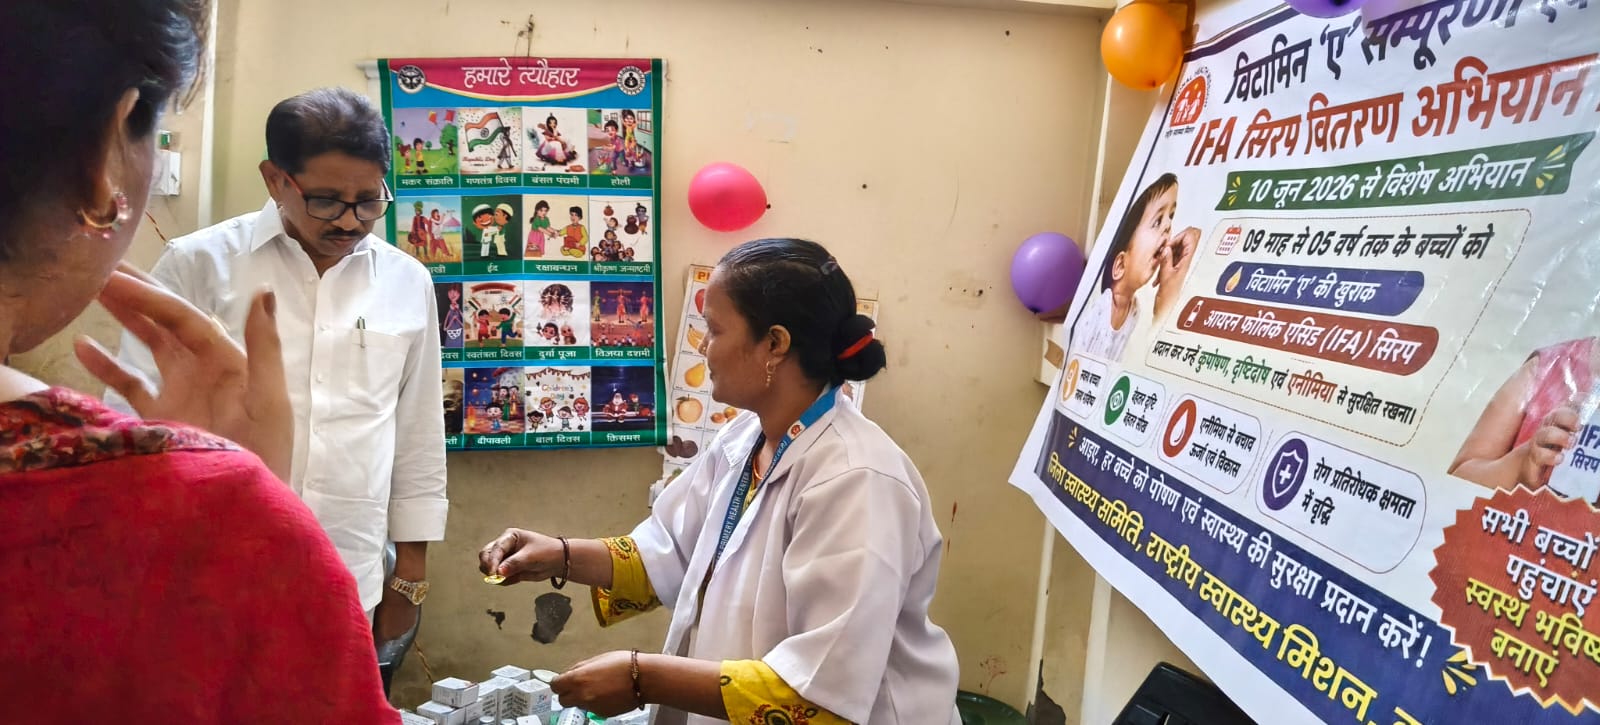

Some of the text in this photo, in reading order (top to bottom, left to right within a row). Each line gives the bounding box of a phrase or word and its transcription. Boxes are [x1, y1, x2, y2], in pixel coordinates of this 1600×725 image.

[461, 57, 580, 88] हमारे त्यौहार
[1224, 34, 1312, 104] विटामिन
[1184, 53, 1598, 166] IFA सिरप वितरण अभियान
[466, 176, 516, 184] गणतंत्र दिवस
[556, 176, 580, 184] पंचमी
[611, 177, 630, 186] होली
[1248, 153, 1536, 208] 10 जून 2026 से विशेष अभियान
[1243, 222, 1495, 259] 09 माह से 05 वर्ष तक के बच्चों को
[487, 262, 498, 273] ईद
[1246, 268, 1296, 294] विटामिन
[1313, 272, 1338, 299] की
[1334, 280, 1382, 308] खुराक
[466, 348, 522, 359] स्वतंत्रता दिवस
[538, 348, 576, 360] दुर्गा पूजा
[595, 348, 650, 357] विजया दशमी
[1204, 310, 1423, 366] आयरन फोलिक एसिड (IFA) सिरप
[1152, 340, 1417, 425] प्रदान कर उन्हें कुपोषण, दृष्टिदोष एवं एनीमिया से सुरक्षित रखना।
[477, 434, 512, 445] दीपावली
[536, 434, 581, 444] बाल दिवस
[1200, 416, 1256, 452] एनीमिया से बचाव
[1189, 442, 1242, 478] ऊर्जा एवं विकास
[728, 496, 741, 520] HEALTH
[740, 472, 750, 496] CENTER
[1302, 488, 1335, 526] में वृद्धि
[1314, 456, 1416, 520] रोग प्रतिरोधक क्षमता
[1078, 436, 1100, 466] आइए,
[1101, 450, 1115, 472] हर
[1113, 456, 1134, 484] बच्चे
[1132, 466, 1150, 493] को
[1149, 474, 1181, 512] पोषण
[1181, 497, 1202, 524] एवं
[1201, 508, 1248, 554] स्वास्थ्य
[1248, 531, 1272, 568] की
[1270, 550, 1322, 600] सुरक्षा
[1320, 580, 1378, 634] प्रदान
[1482, 506, 1600, 570] सभी बच्चों
[1047, 451, 1378, 725] जिला स्वास्थ्य समिति, राष्ट्रीय स्वास्थ्य मिशन
[1506, 554, 1598, 617] पहुंचाएं
[1465, 578, 1600, 664] स्वस्थ भविष्
[1491, 628, 1560, 688] बनाएं
